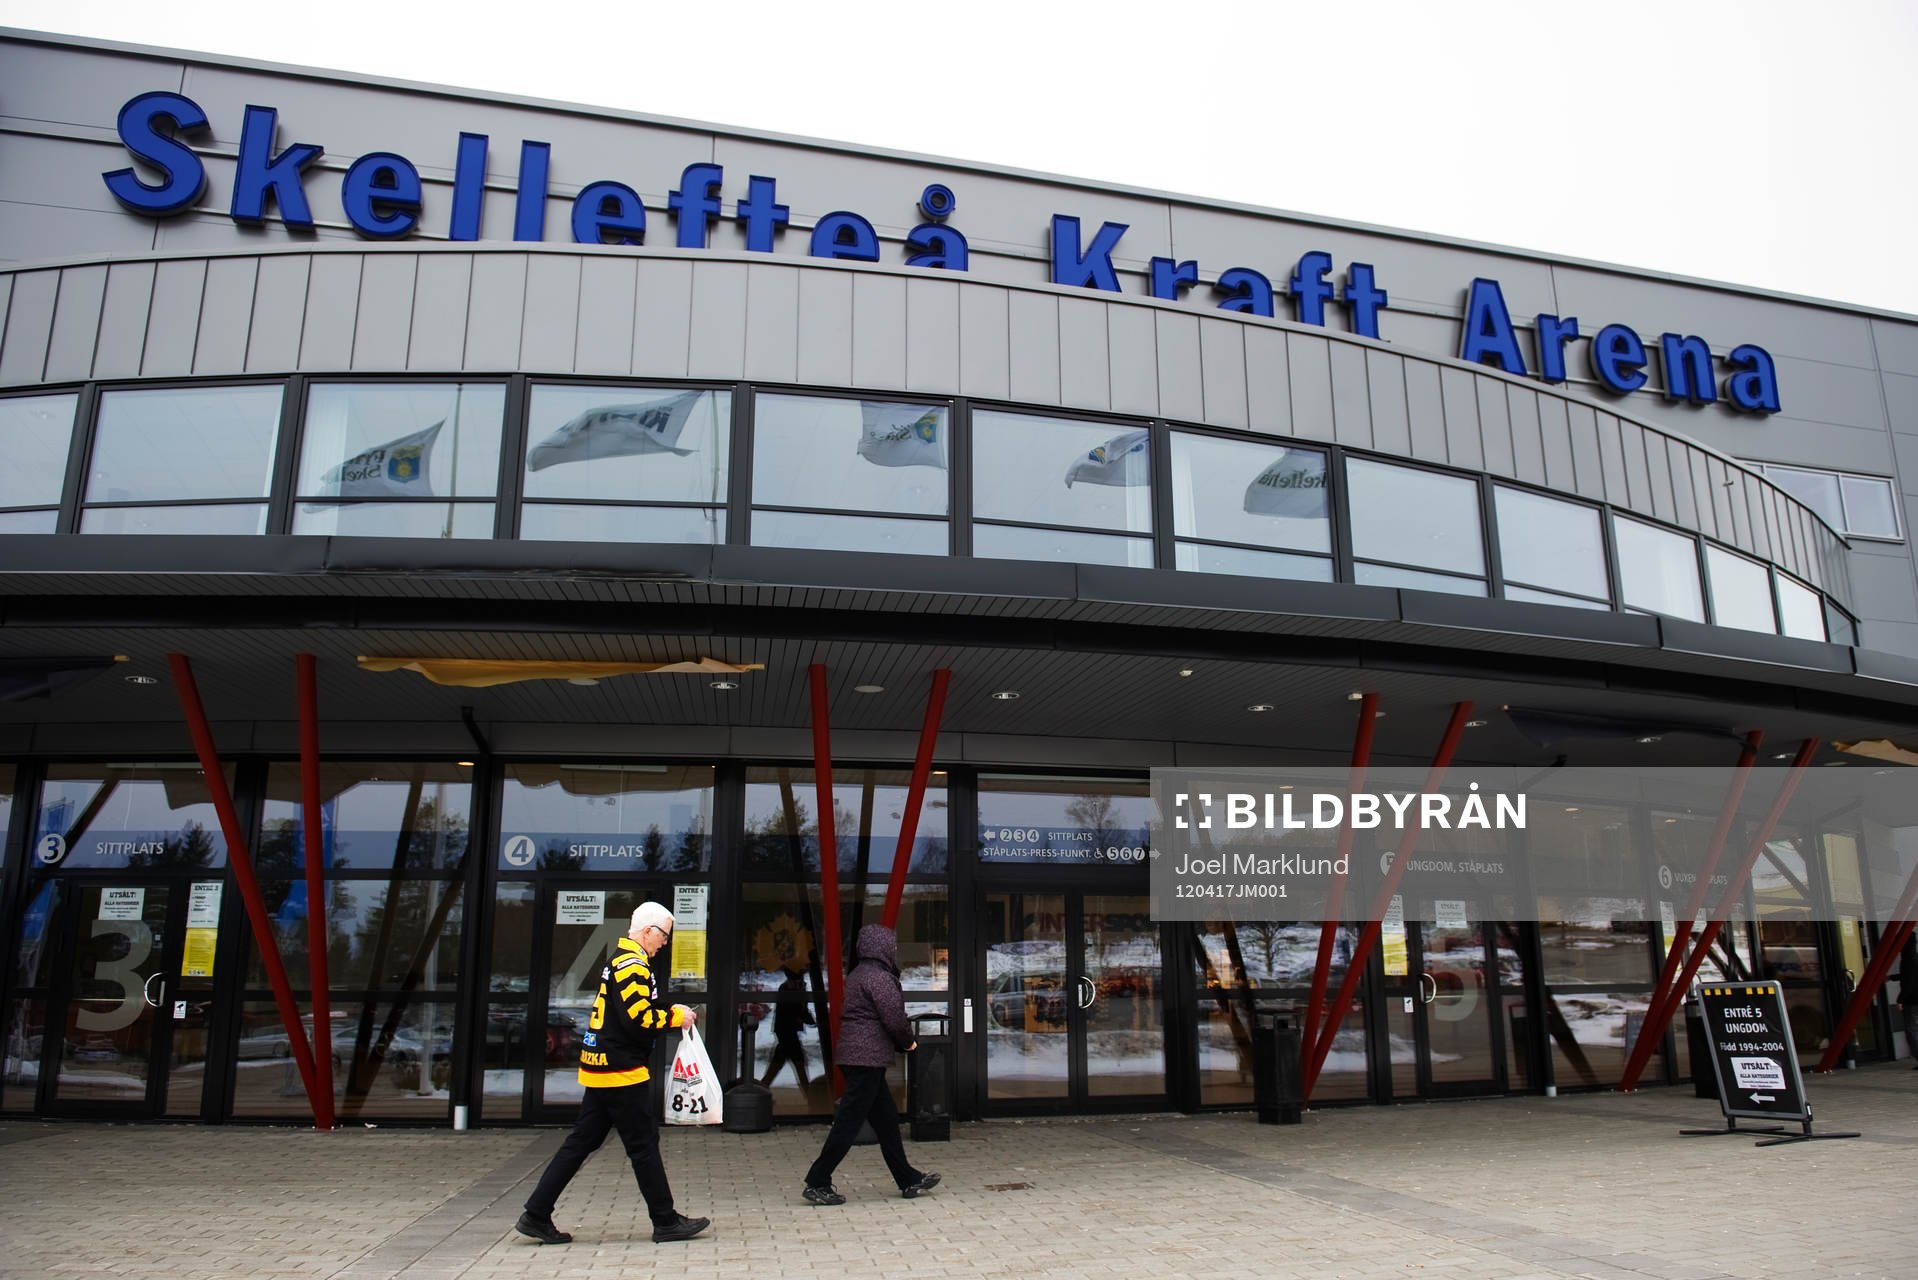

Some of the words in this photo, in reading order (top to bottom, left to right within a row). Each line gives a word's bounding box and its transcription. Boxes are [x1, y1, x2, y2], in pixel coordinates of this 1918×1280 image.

[102, 91, 969, 272] Skellefteå
[1049, 213, 1388, 342] Kraft
[1459, 277, 1781, 415] Arena
[1001, 830, 1011, 842] 2
[1014, 830, 1024, 842] 3
[1028, 830, 1038, 842] 4
[1048, 832, 1092, 842] SITTPLATS
[42, 836, 62, 861] 3
[96, 842, 164, 854] SITTPLATS
[508, 838, 532, 864] 4
[570, 844, 644, 858] SITTPLATS
[1108, 848, 1118, 860] 5
[1121, 848, 1131, 860] 6
[1134, 848, 1144, 860] 7
[1458, 860, 1504, 874] STÅPLATS
[75, 919, 153, 1032] 3
[1724, 1005, 1754, 1018] ENTRÉ
[1756, 1008, 1763, 1018] 5
[1725, 1023, 1768, 1033] UNGDOM
[1739, 1042, 1784, 1051] 1994-2004
[672, 1094, 708, 1114] 8-21
